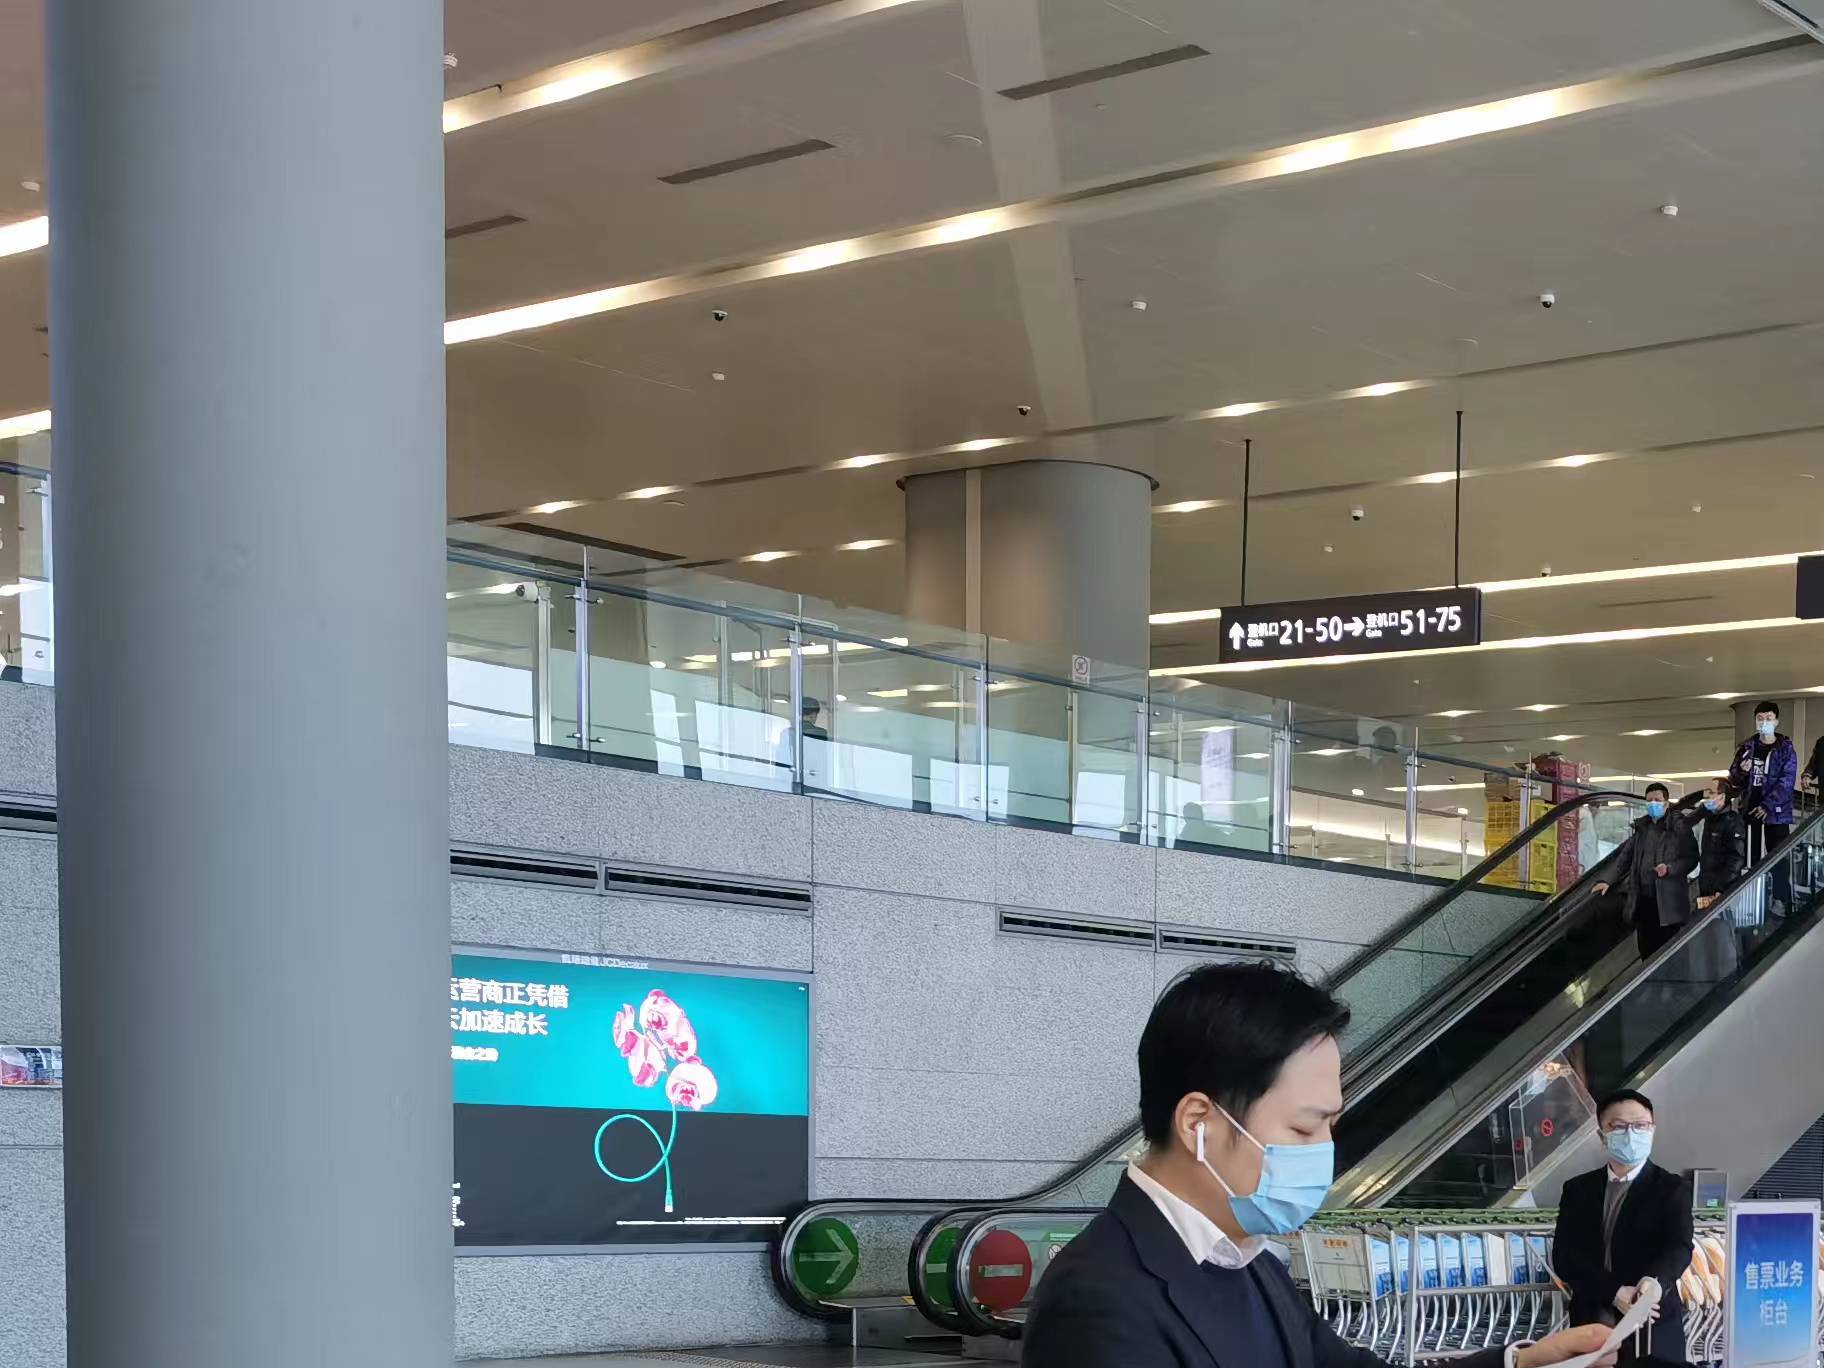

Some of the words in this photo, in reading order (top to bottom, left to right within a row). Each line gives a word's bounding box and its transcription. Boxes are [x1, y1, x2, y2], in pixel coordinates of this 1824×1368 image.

[1247, 622, 1279, 638] 登机口
[1279, 616, 1343, 646] 21-50
[1365, 612, 1399, 628] 登机口
[1400, 605, 1462, 636] 51-75
[1744, 1260, 1804, 1290] 售票业务
